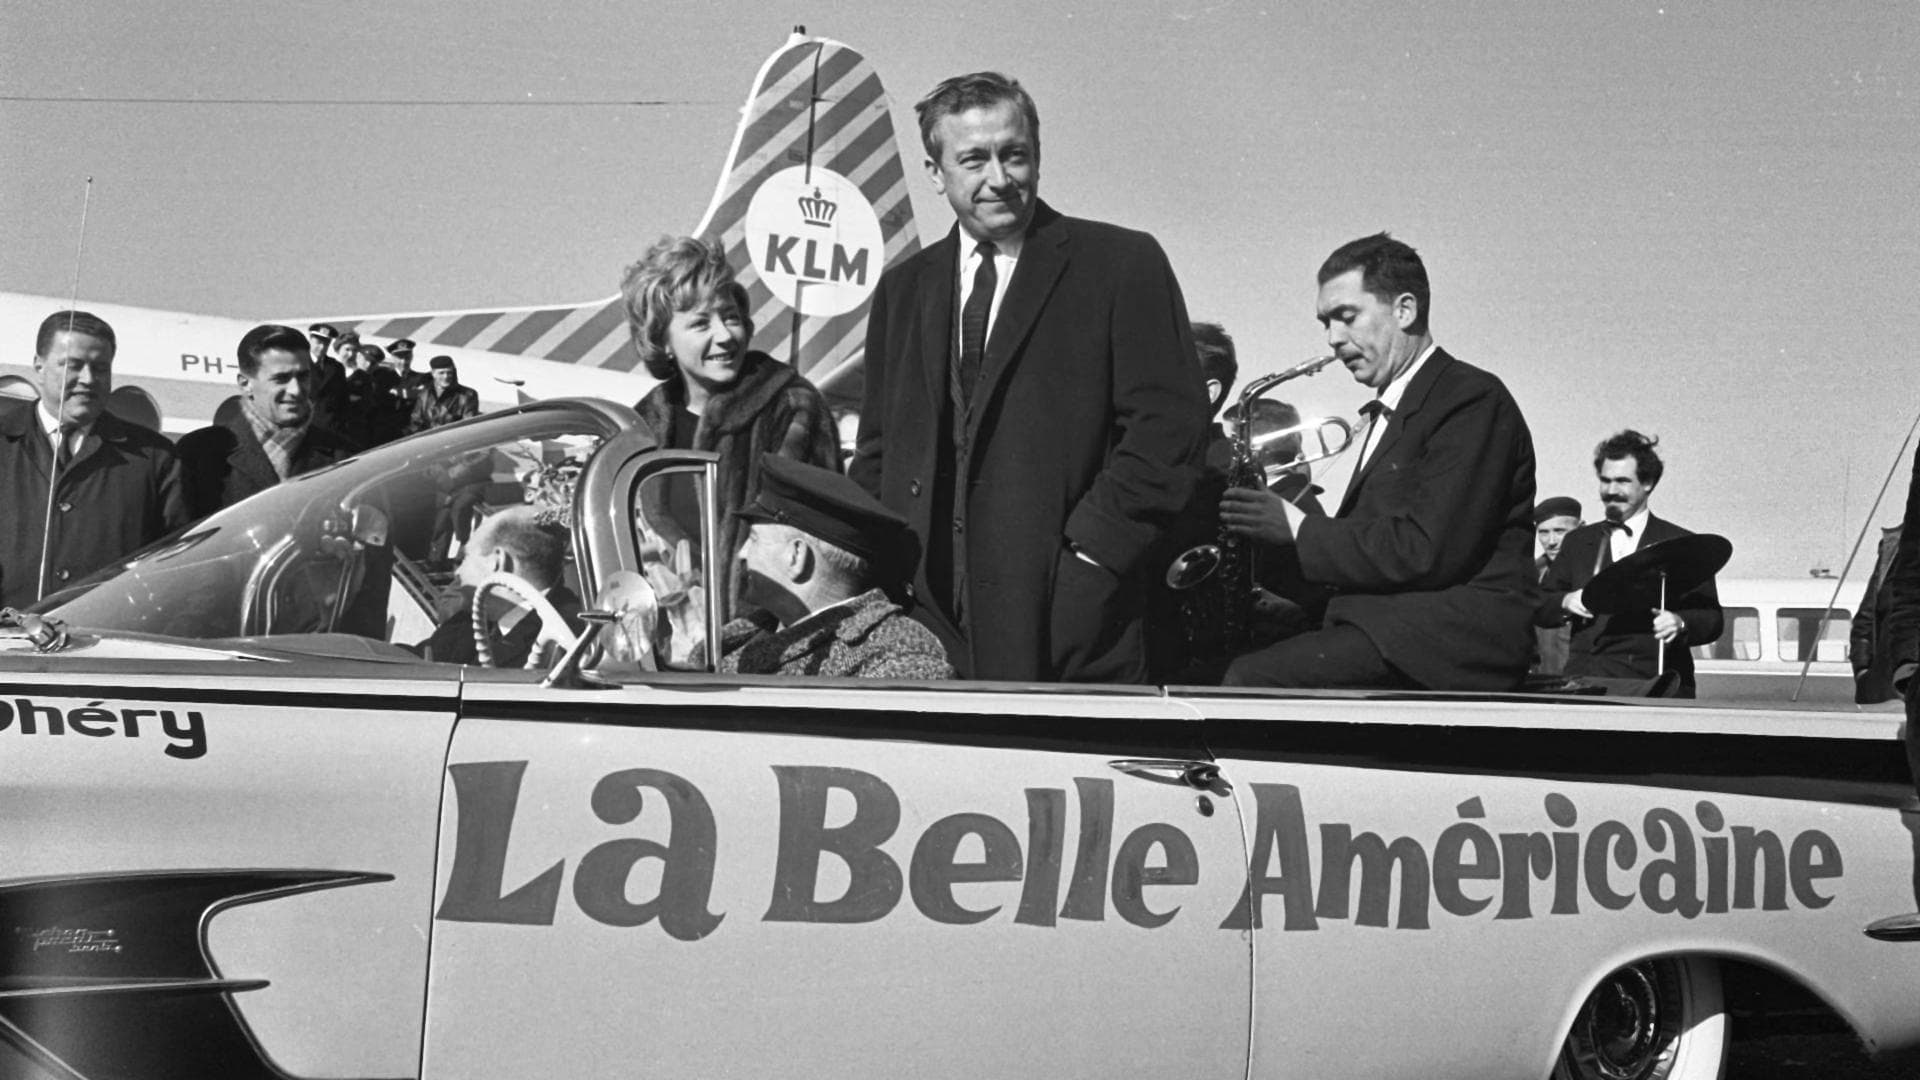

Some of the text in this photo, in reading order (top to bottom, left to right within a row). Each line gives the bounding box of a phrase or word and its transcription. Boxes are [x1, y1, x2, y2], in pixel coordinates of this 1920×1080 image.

[764, 233, 869, 286] KLM
[435, 760, 1844, 941] La Belle Américaine
